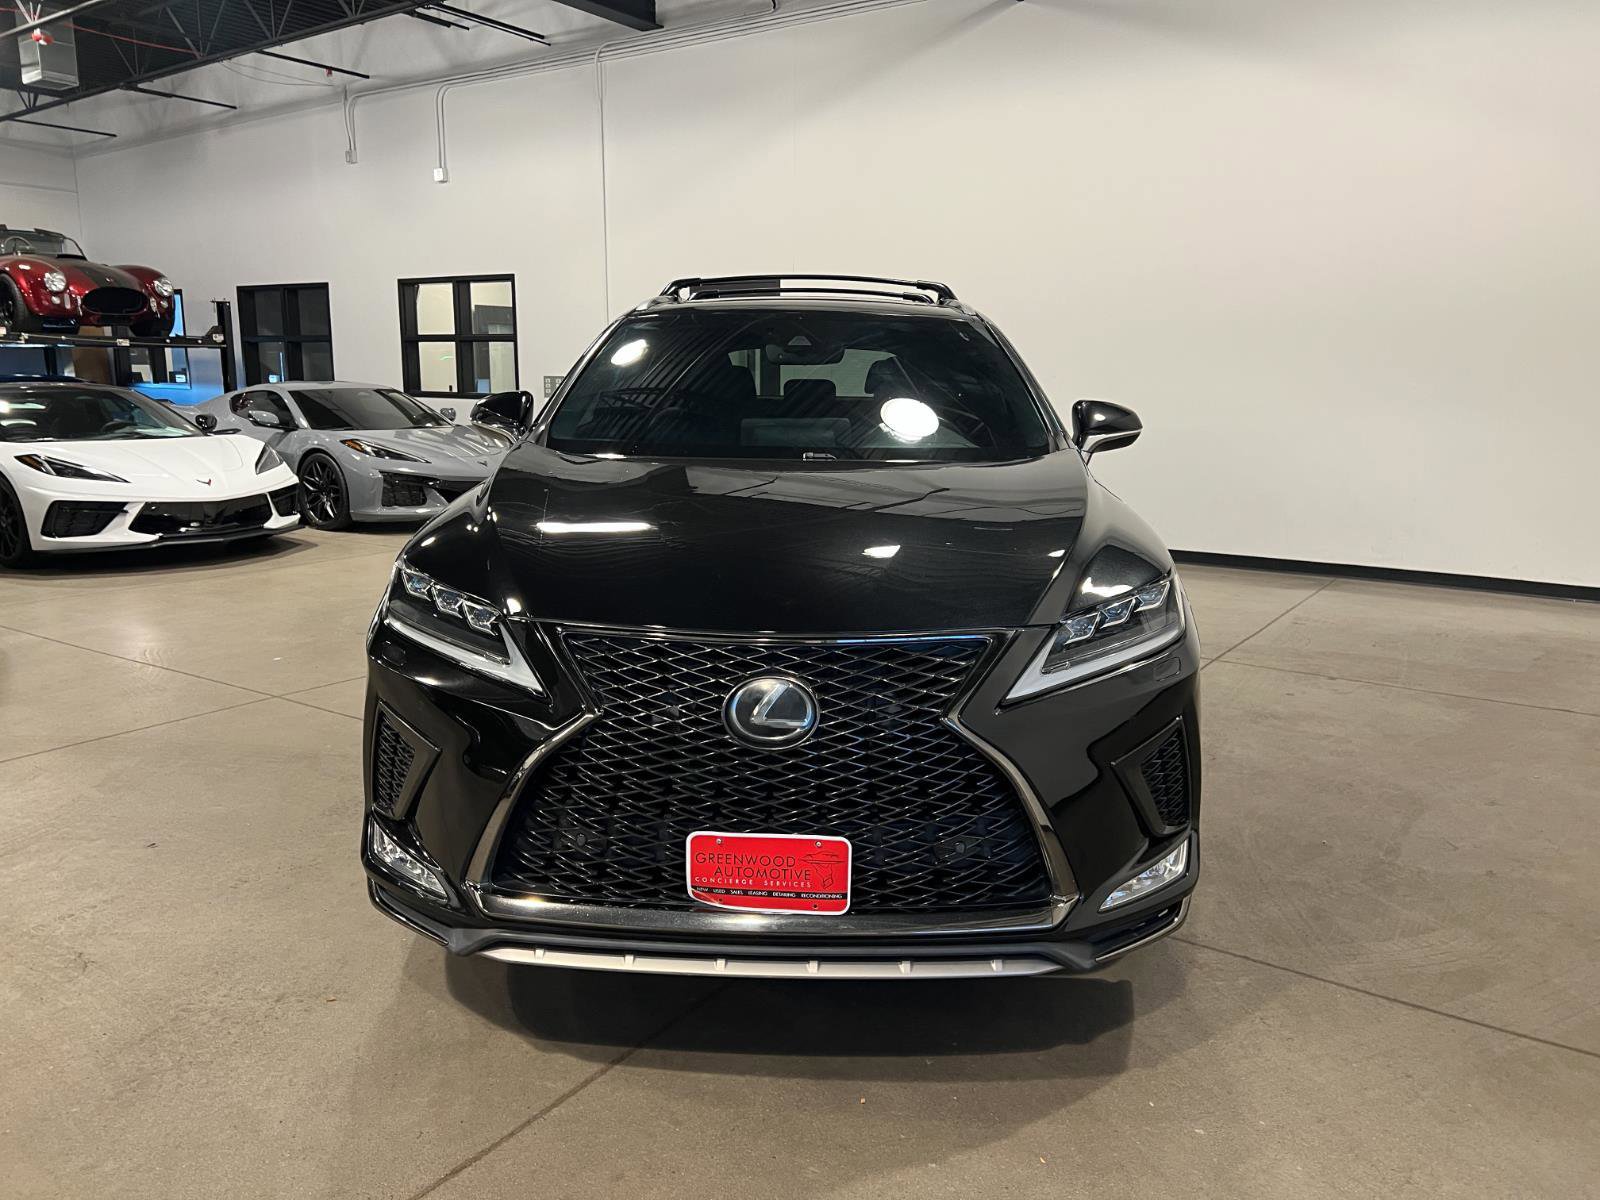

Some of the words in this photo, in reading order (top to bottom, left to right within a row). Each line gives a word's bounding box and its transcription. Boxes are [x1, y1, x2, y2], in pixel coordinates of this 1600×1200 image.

[695, 852, 796, 868] GREENWOOD
[714, 866, 811, 881] AUTOMOTIVE
[695, 876, 753, 886] CONCIERGE
[763, 880, 811, 888] SERVICES
